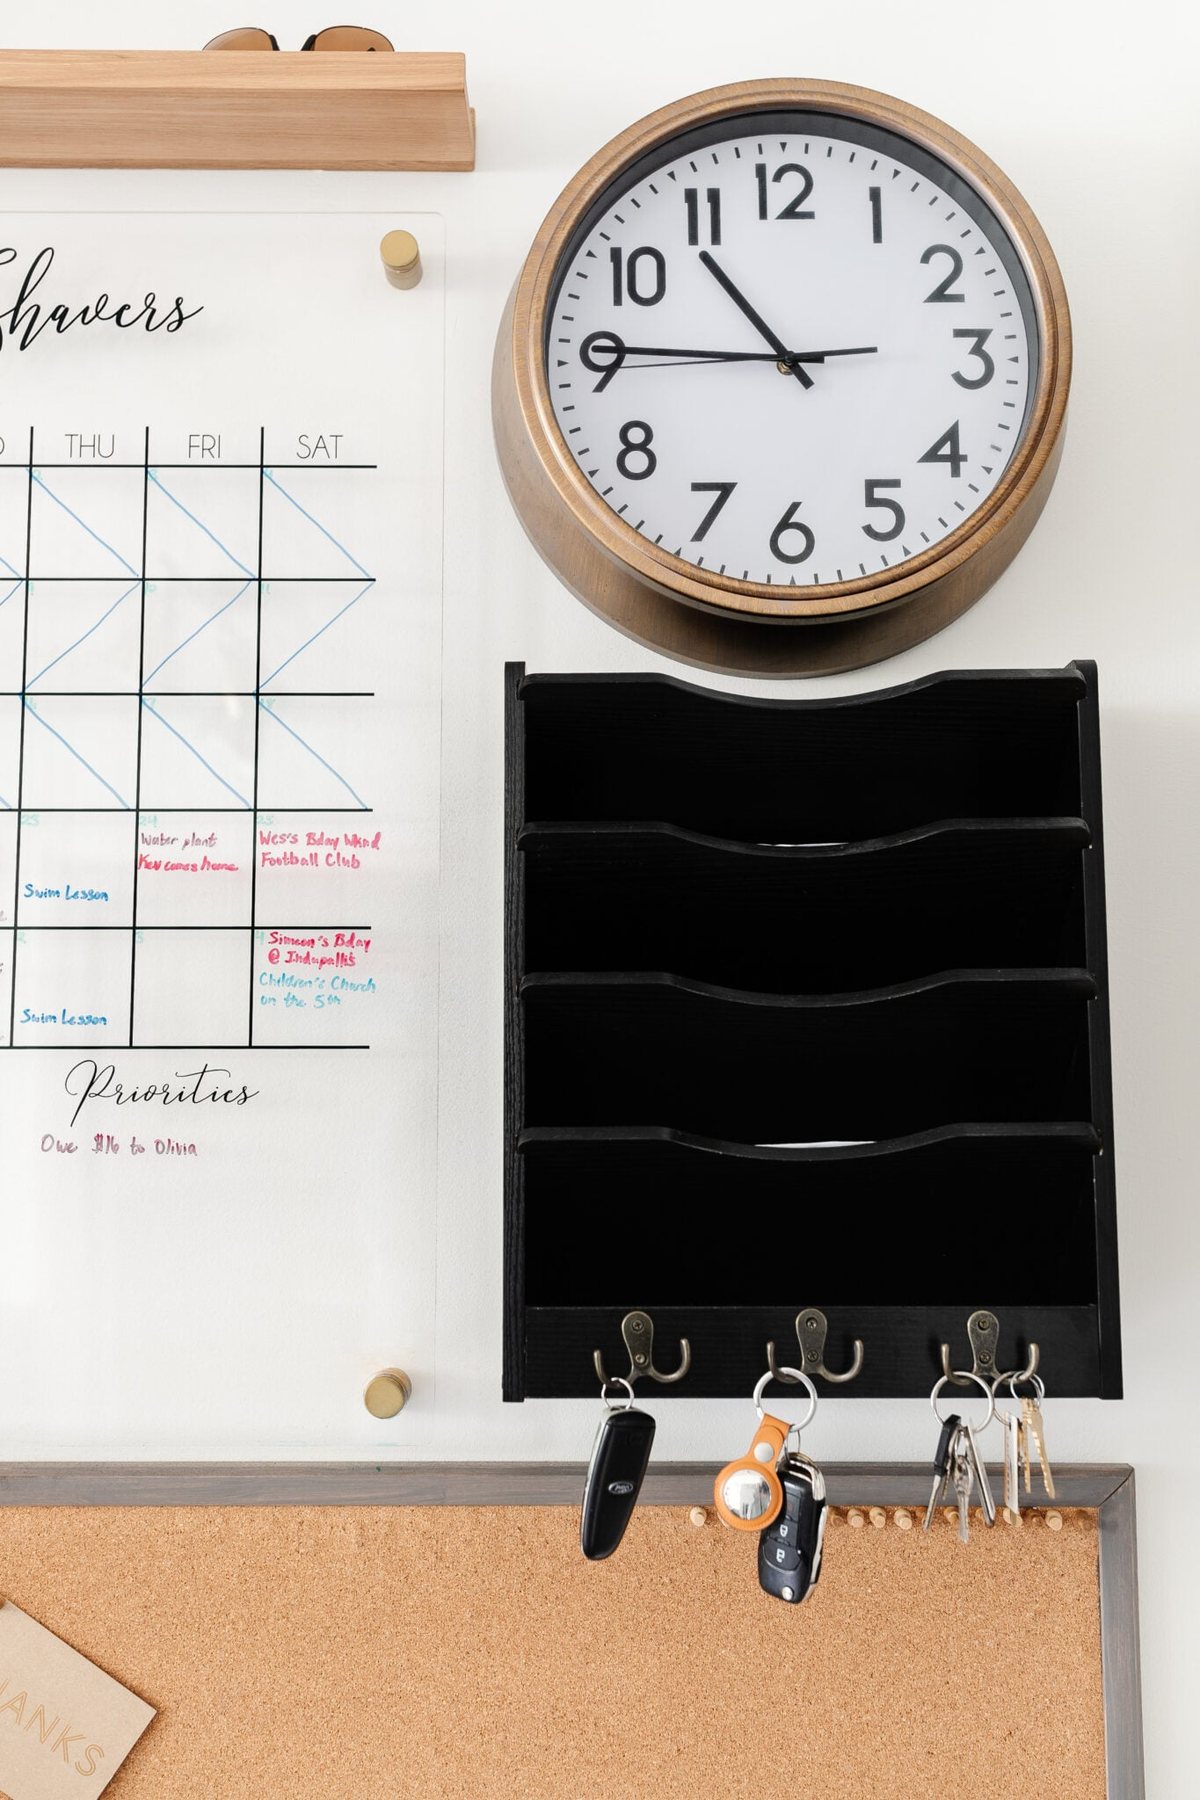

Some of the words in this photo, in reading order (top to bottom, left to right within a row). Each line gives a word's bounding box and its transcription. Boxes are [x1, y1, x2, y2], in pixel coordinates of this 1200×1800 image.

[684, 187, 721, 246] 11
[755, 163, 815, 221] 12
[868, 186, 883, 244] 1
[0, 247, 204, 351] havers
[610, 246, 666, 307] 10
[919, 244, 966, 303] 2
[579, 330, 627, 393] 9
[950, 328, 995, 390] 3
[65, 433, 115, 459] THU
[188, 434, 221, 459] FRI
[296, 434, 343, 460] SAT
[616, 419, 657, 481] 8
[916, 419, 968, 478] 4
[690, 482, 738, 542] 7
[769, 501, 816, 564] 6
[861, 478, 906, 542] 5
[182, 831, 218, 850] plant
[261, 850, 319, 867] Football
[325, 851, 361, 869] Club
[23, 883, 61, 899] Swim
[65, 885, 109, 902] Lesson
[268, 948, 281, 965] @
[20, 1009, 58, 1024] Swim
[61, 1008, 108, 1026] Lesson
[65, 1059, 260, 1128] Priorities
[129, 1136, 146, 1156] to
[153, 1138, 199, 1157] Olivia
[0, 1678, 105, 1777] ANKS
